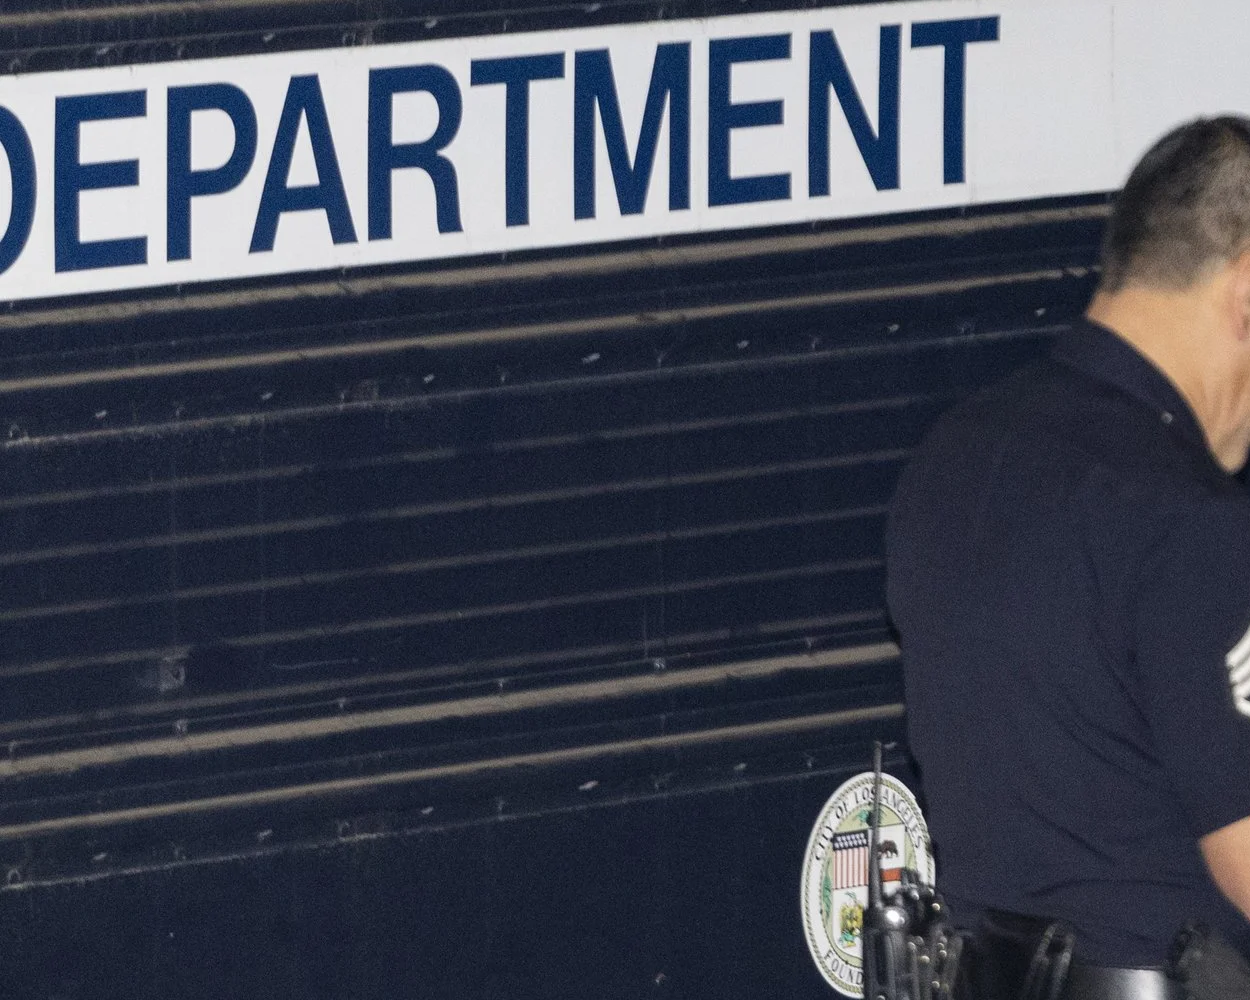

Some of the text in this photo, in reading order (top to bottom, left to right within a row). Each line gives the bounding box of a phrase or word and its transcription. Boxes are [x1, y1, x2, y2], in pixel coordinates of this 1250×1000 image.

[815, 786, 923, 861] CITY OF LOS ANGELES
[823, 949, 864, 985] FOUND
